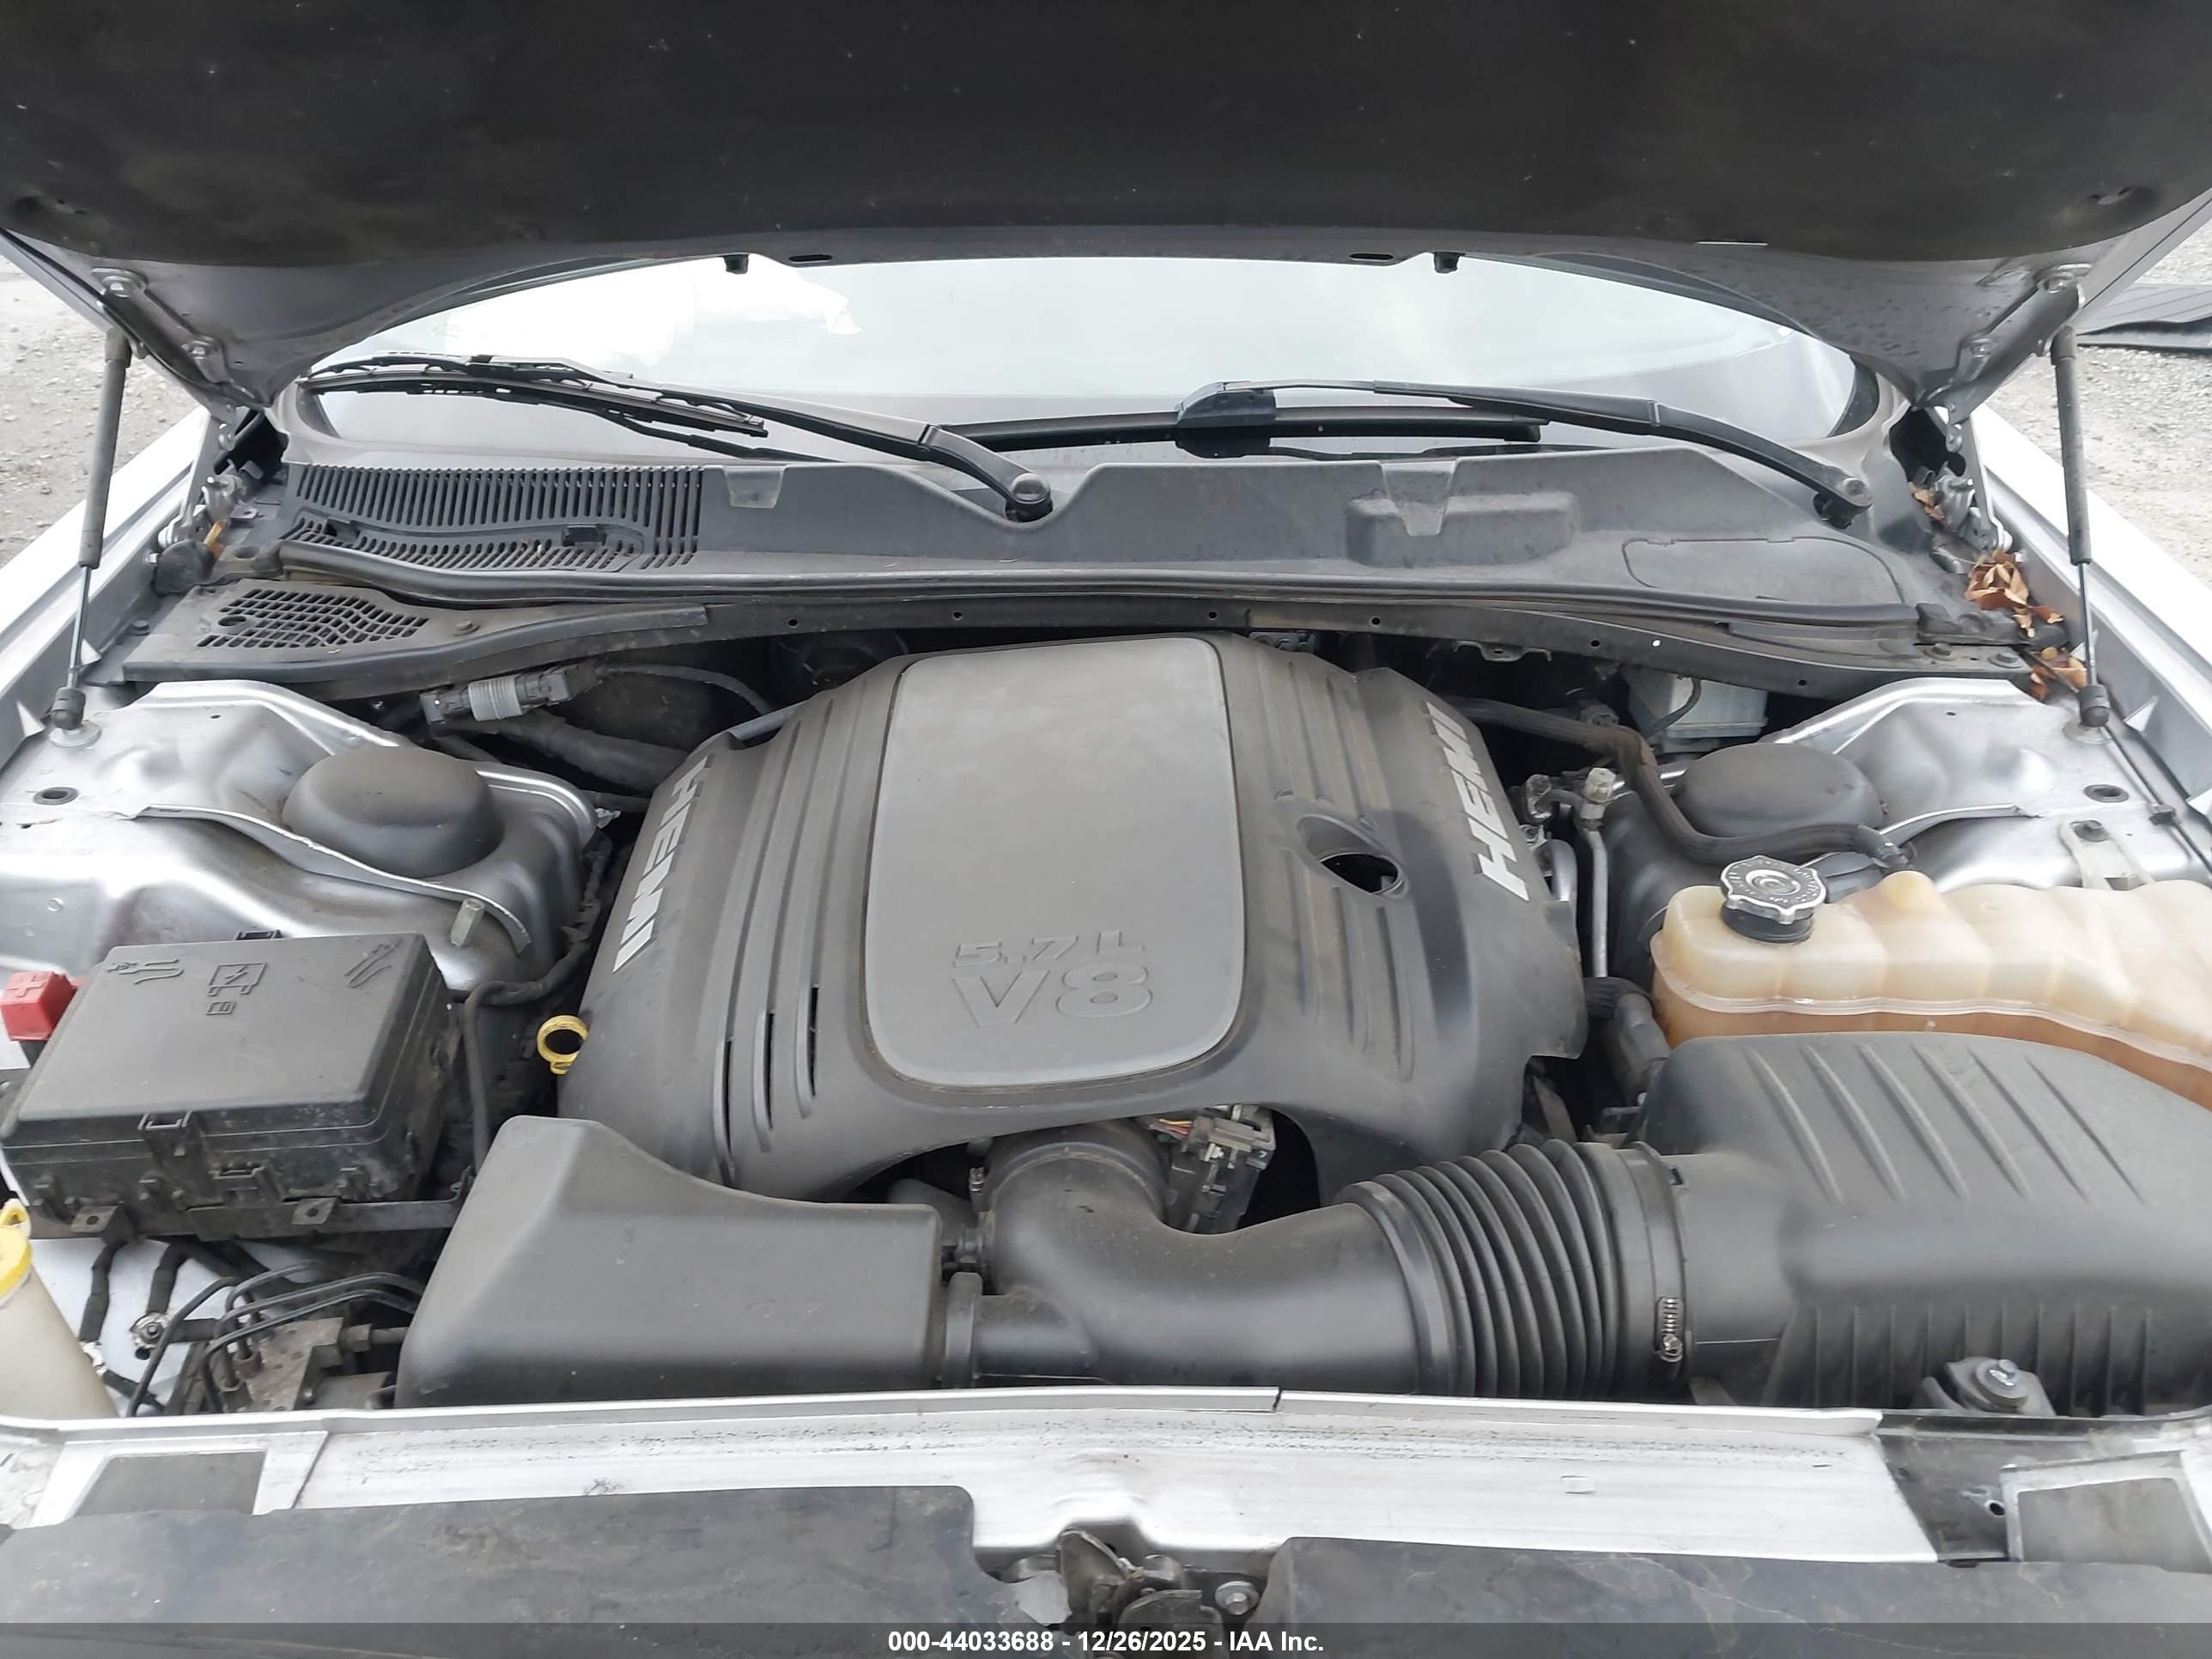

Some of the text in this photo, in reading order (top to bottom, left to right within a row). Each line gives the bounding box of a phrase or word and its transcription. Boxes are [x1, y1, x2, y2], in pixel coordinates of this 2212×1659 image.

[612, 756, 708, 973] HEMI
[1425, 702, 1530, 902] HEMI
[951, 962, 1153, 1028] V8
